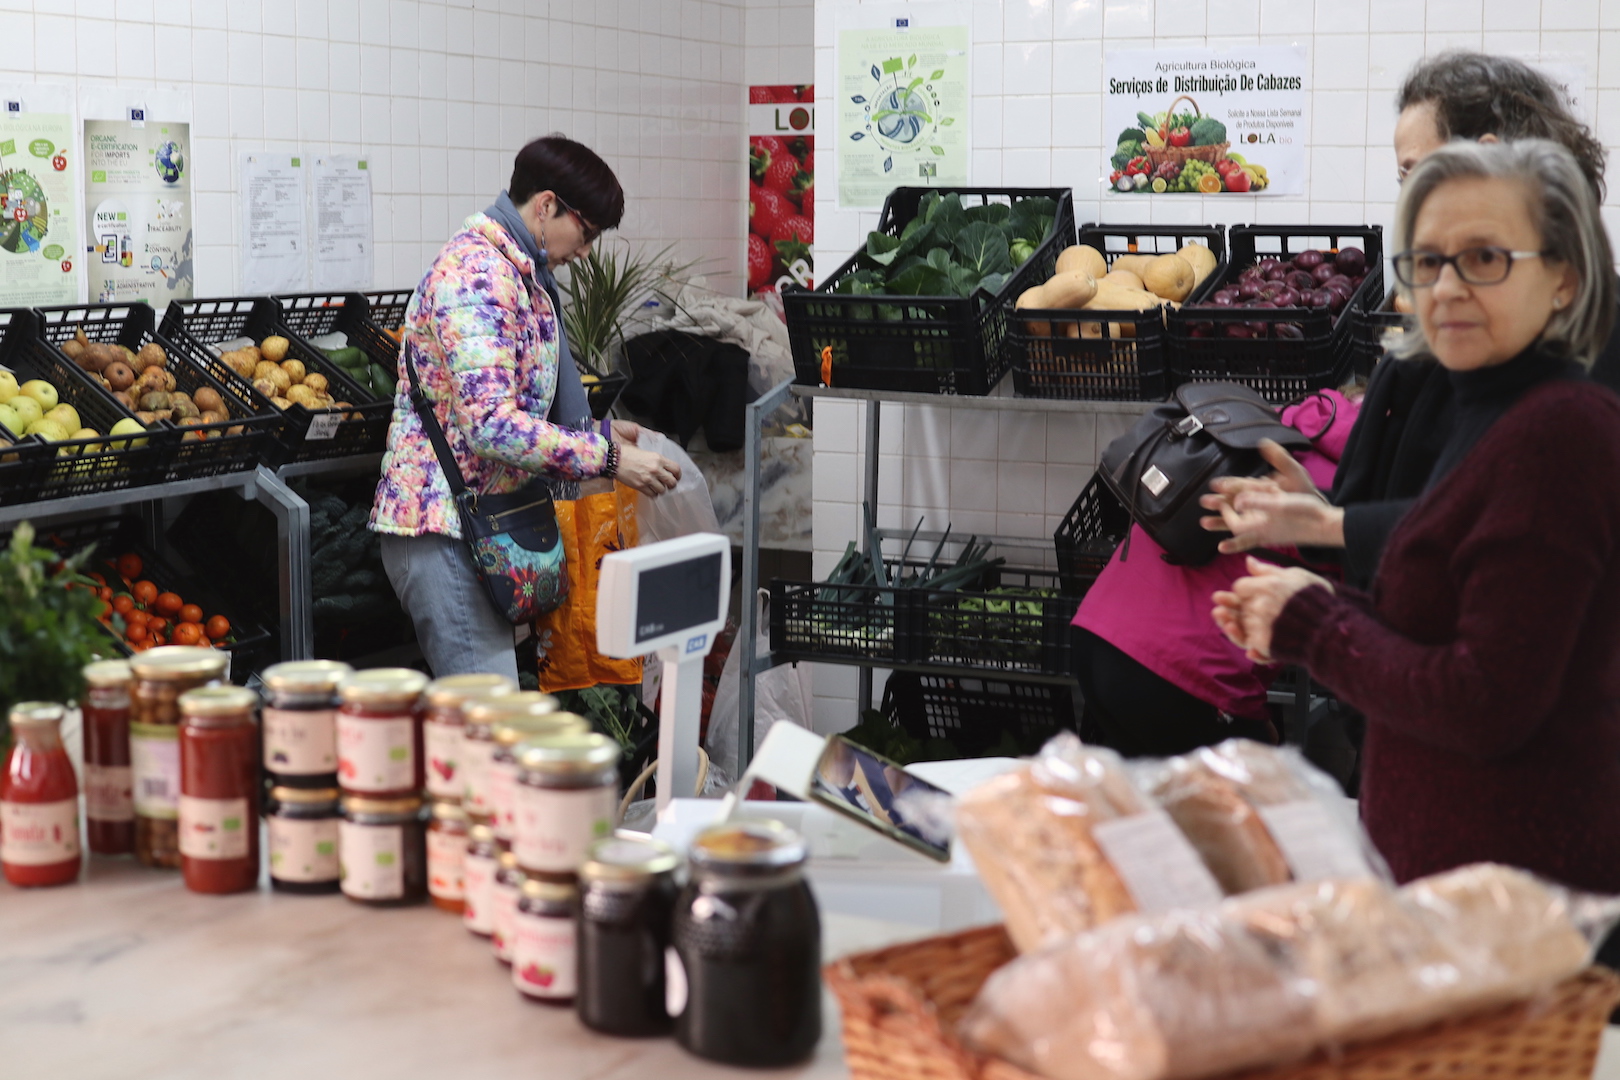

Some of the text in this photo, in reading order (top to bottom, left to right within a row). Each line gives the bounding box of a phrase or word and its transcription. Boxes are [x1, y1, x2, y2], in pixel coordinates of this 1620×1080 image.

[1155, 59, 1256, 73] Agricultura Biológica
[1110, 73, 1302, 98] Serviços de Distribuição De Cabazes
[1227, 109, 1245, 118] Solicite
[1250, 109, 1266, 117] Nossa
[1267, 109, 1279, 117] Lista
[1279, 108, 1302, 117] Semanal
[1236, 120, 1242, 129] de
[1243, 120, 1265, 129] Produtos
[90, 135, 117, 143] ORGANIC
[1240, 132, 1293, 145] LOLA bio
[90, 143, 138, 151] E-CERTIFICATION
[104, 151, 130, 159] IMPORTS
[107, 159, 118, 167] THE
[97, 212, 116, 221] NEW
[145, 243, 149, 253] 2
[104, 280, 109, 289] 3
